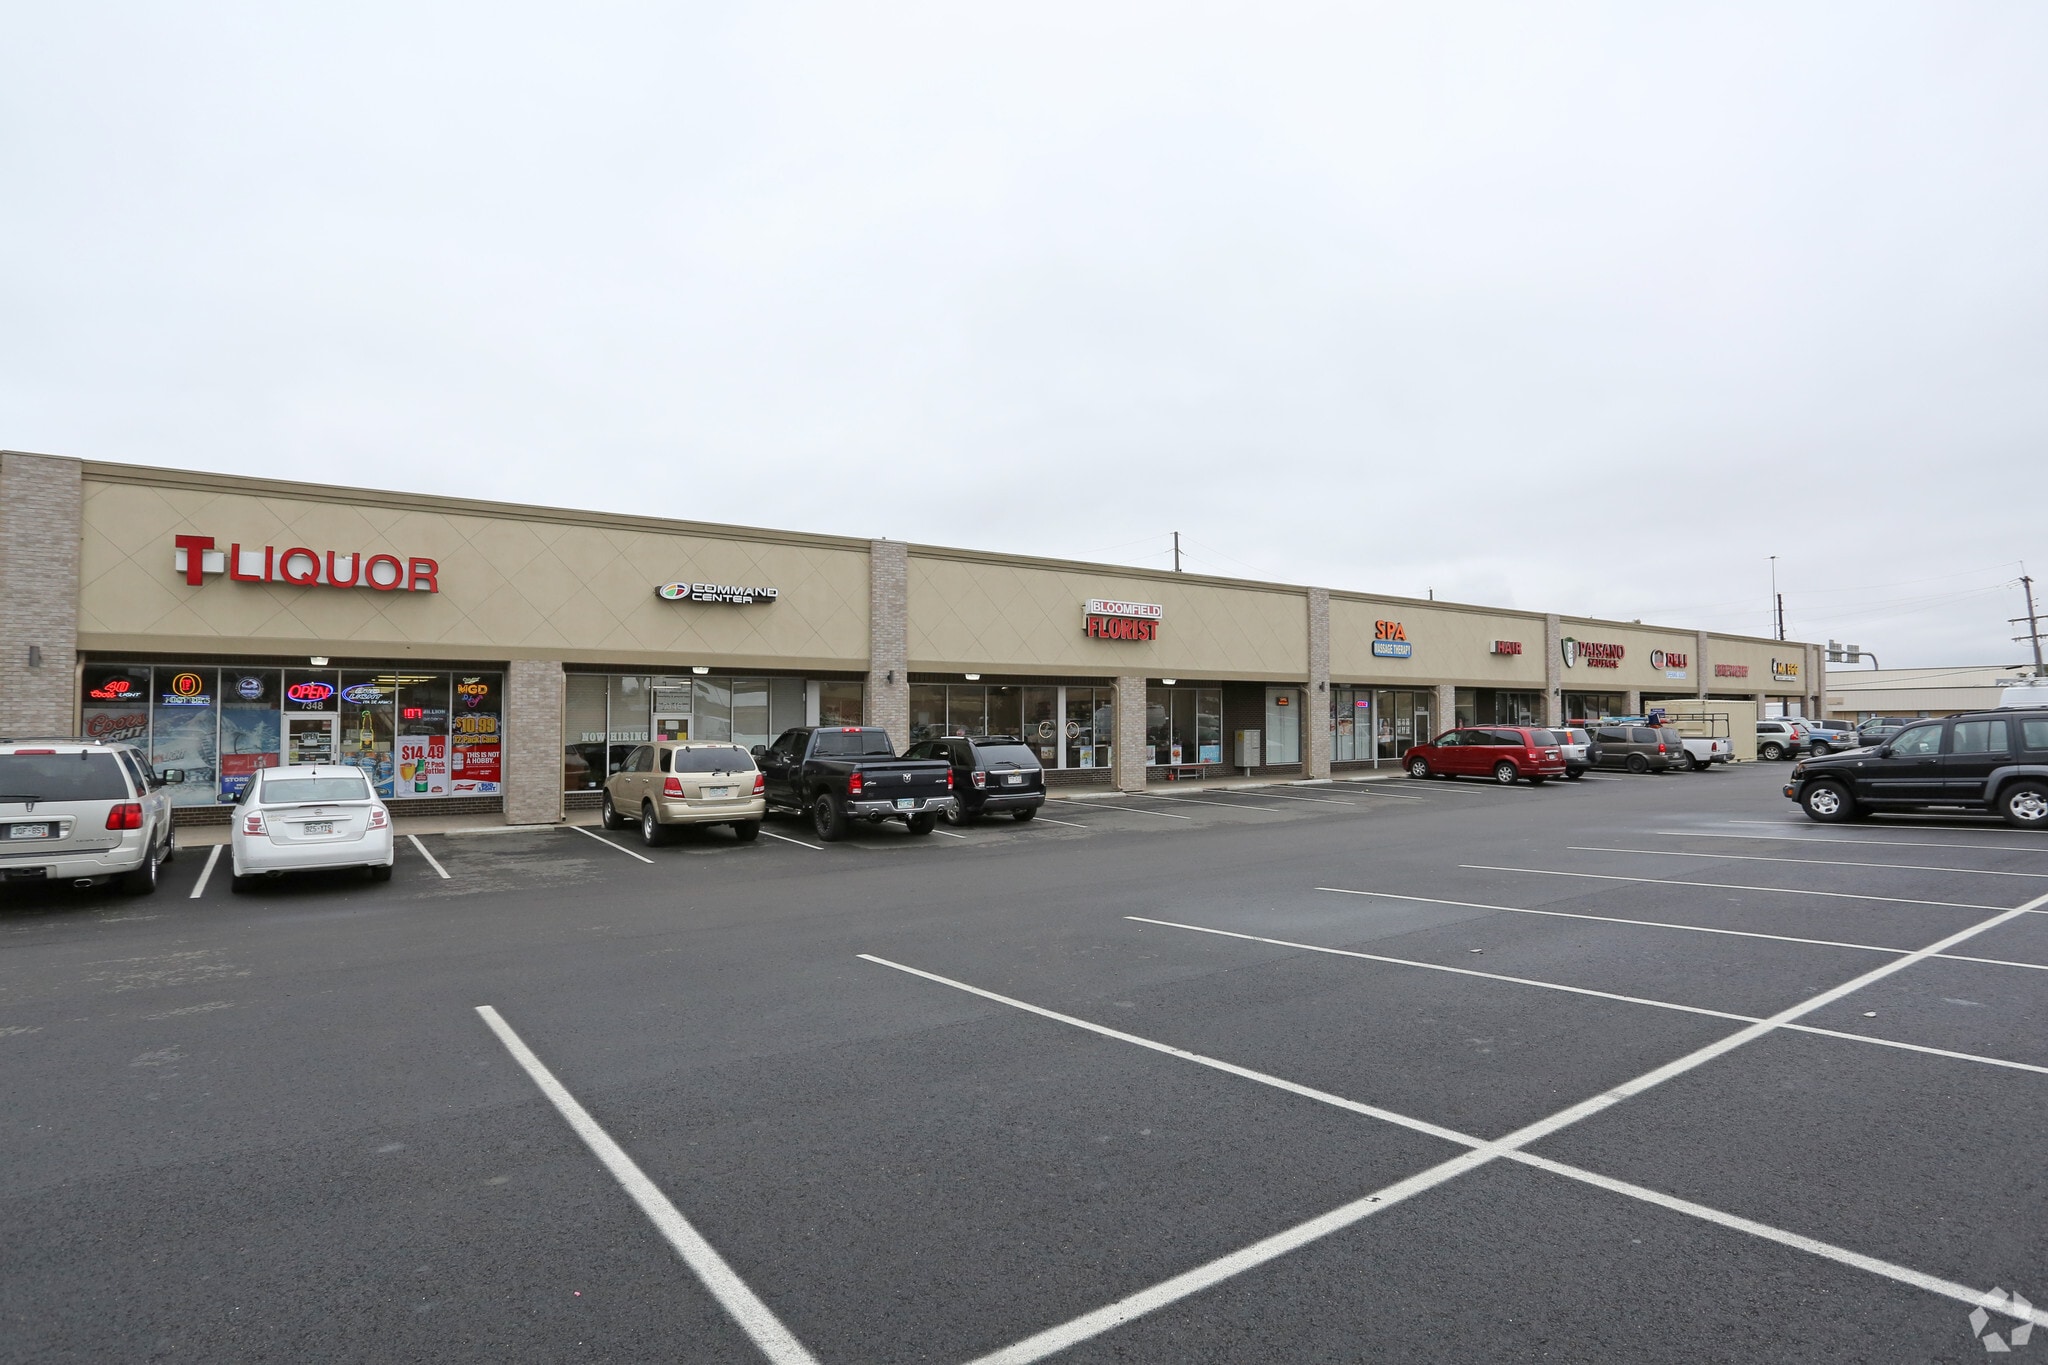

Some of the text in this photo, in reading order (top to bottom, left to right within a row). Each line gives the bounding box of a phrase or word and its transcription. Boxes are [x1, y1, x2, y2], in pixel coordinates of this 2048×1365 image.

[175, 535, 439, 593] T LIQUOR
[692, 583, 779, 597] COMMAND
[692, 593, 753, 604] CENTER
[1093, 601, 1160, 616] BLOOMFIELD
[1088, 617, 1159, 640] FLORIST
[1375, 619, 1407, 641] SPA
[1374, 643, 1411, 656] MASSAGE THERAPY
[1497, 641, 1523, 655] HAIR
[1578, 641, 1625, 660] PAISANO
[1587, 658, 1620, 669] SAUSAGE
[1666, 652, 1688, 668] DELI
[104, 681, 130, 693] 40
[288, 684, 330, 700] OPEN
[457, 684, 488, 695] MGD
[302, 702, 324, 711] 7348
[86, 713, 147, 737] Coors
[455, 717, 497, 733] $10.99
[463, 735, 480, 744] Pack
[481, 735, 499, 744] Cans
[581, 731, 649, 742] NOW HIRING
[402, 745, 445, 761] $14.49
[224, 776, 249, 784] STORE
